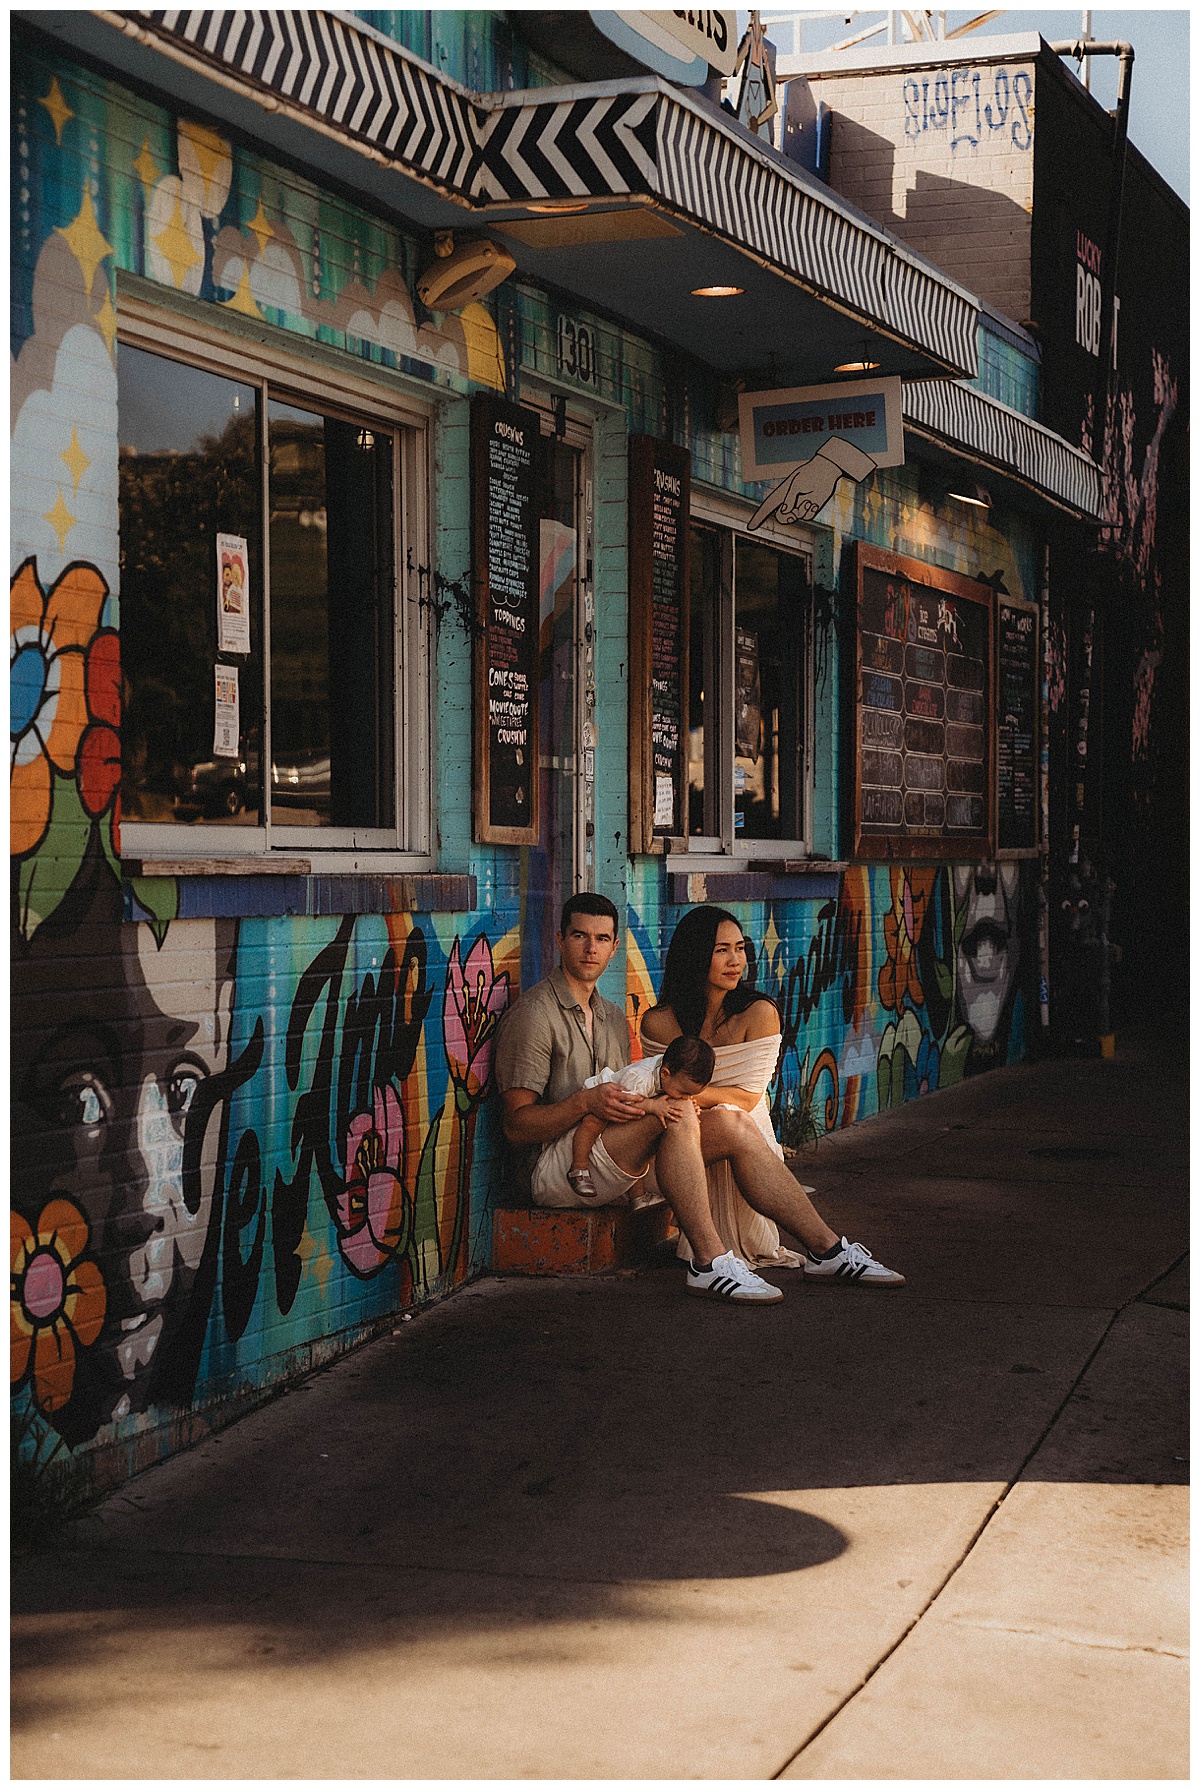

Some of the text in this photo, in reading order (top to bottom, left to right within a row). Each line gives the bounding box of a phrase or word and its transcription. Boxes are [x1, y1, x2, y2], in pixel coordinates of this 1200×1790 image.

[1076, 229, 1101, 275] LUCKY
[1076, 262, 1121, 371] ROBT
[559, 316, 597, 386] 1301
[763, 411, 876, 437] ORDER HERE
[494, 608, 526, 633] TOPPINGS
[489, 667, 514, 690] CONES
[489, 699, 529, 717] MOVIE QUOTE
